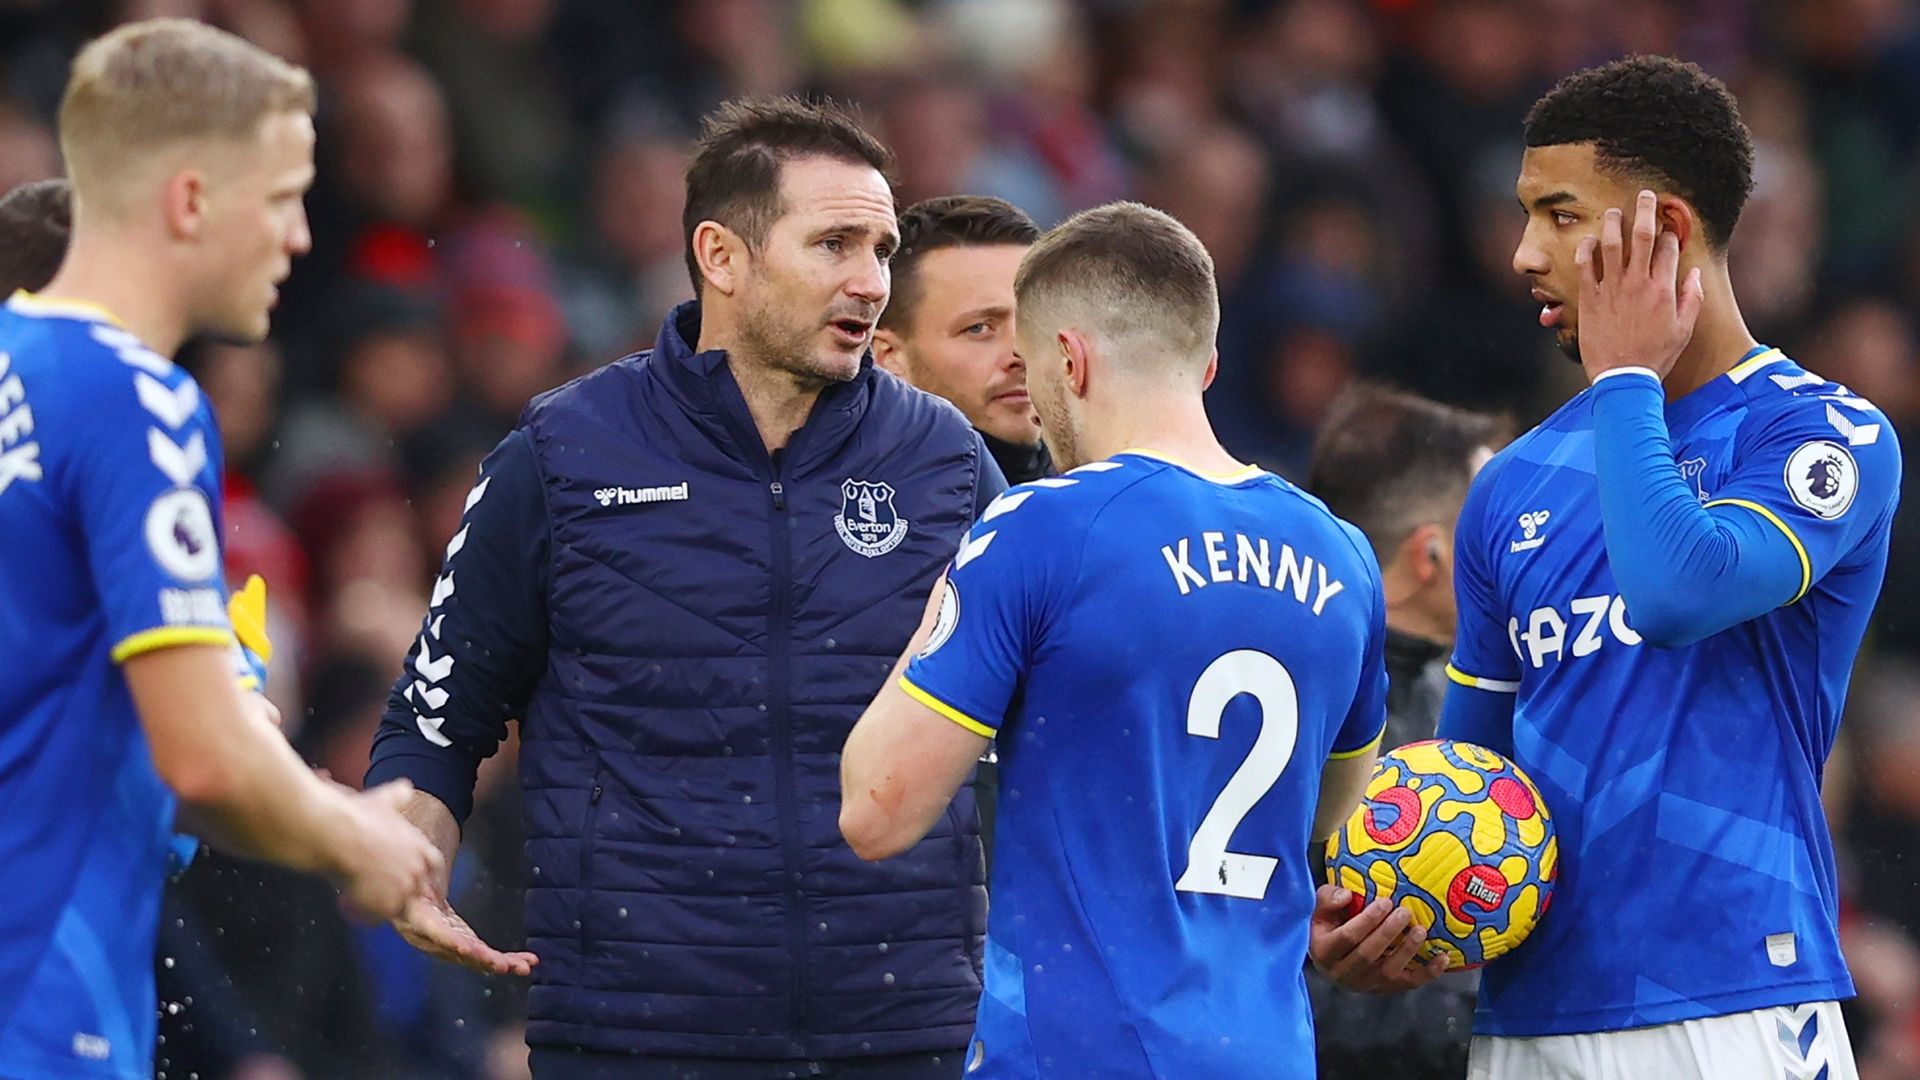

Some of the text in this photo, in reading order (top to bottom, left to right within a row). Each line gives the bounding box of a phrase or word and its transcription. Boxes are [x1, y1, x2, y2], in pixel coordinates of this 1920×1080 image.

[0, 350, 43, 495] EEK
[617, 481, 689, 505] hummel
[847, 518, 892, 533] Everton
[1160, 531, 1345, 617] KENNY
[1174, 648, 1299, 900] 2
[1466, 881, 1501, 904] FLIGHT
